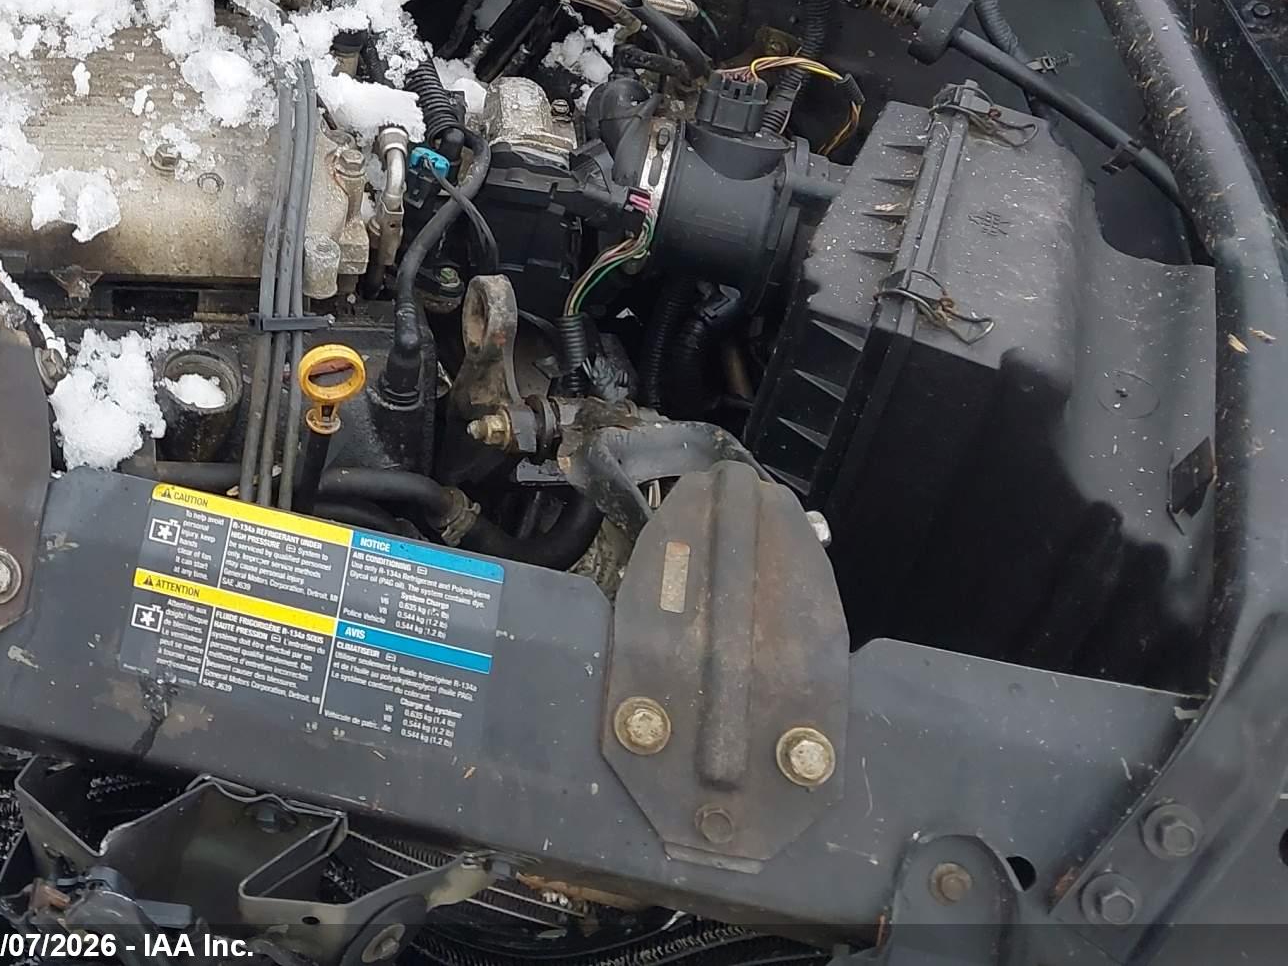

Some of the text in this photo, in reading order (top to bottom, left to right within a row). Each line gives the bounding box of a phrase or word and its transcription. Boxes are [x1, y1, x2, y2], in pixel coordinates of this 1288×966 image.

[174, 492, 209, 507] CAUTION
[360, 537, 391, 552] NOTICE
[155, 579, 200, 597] ATTENTION
[344, 626, 366, 640] AVIS
